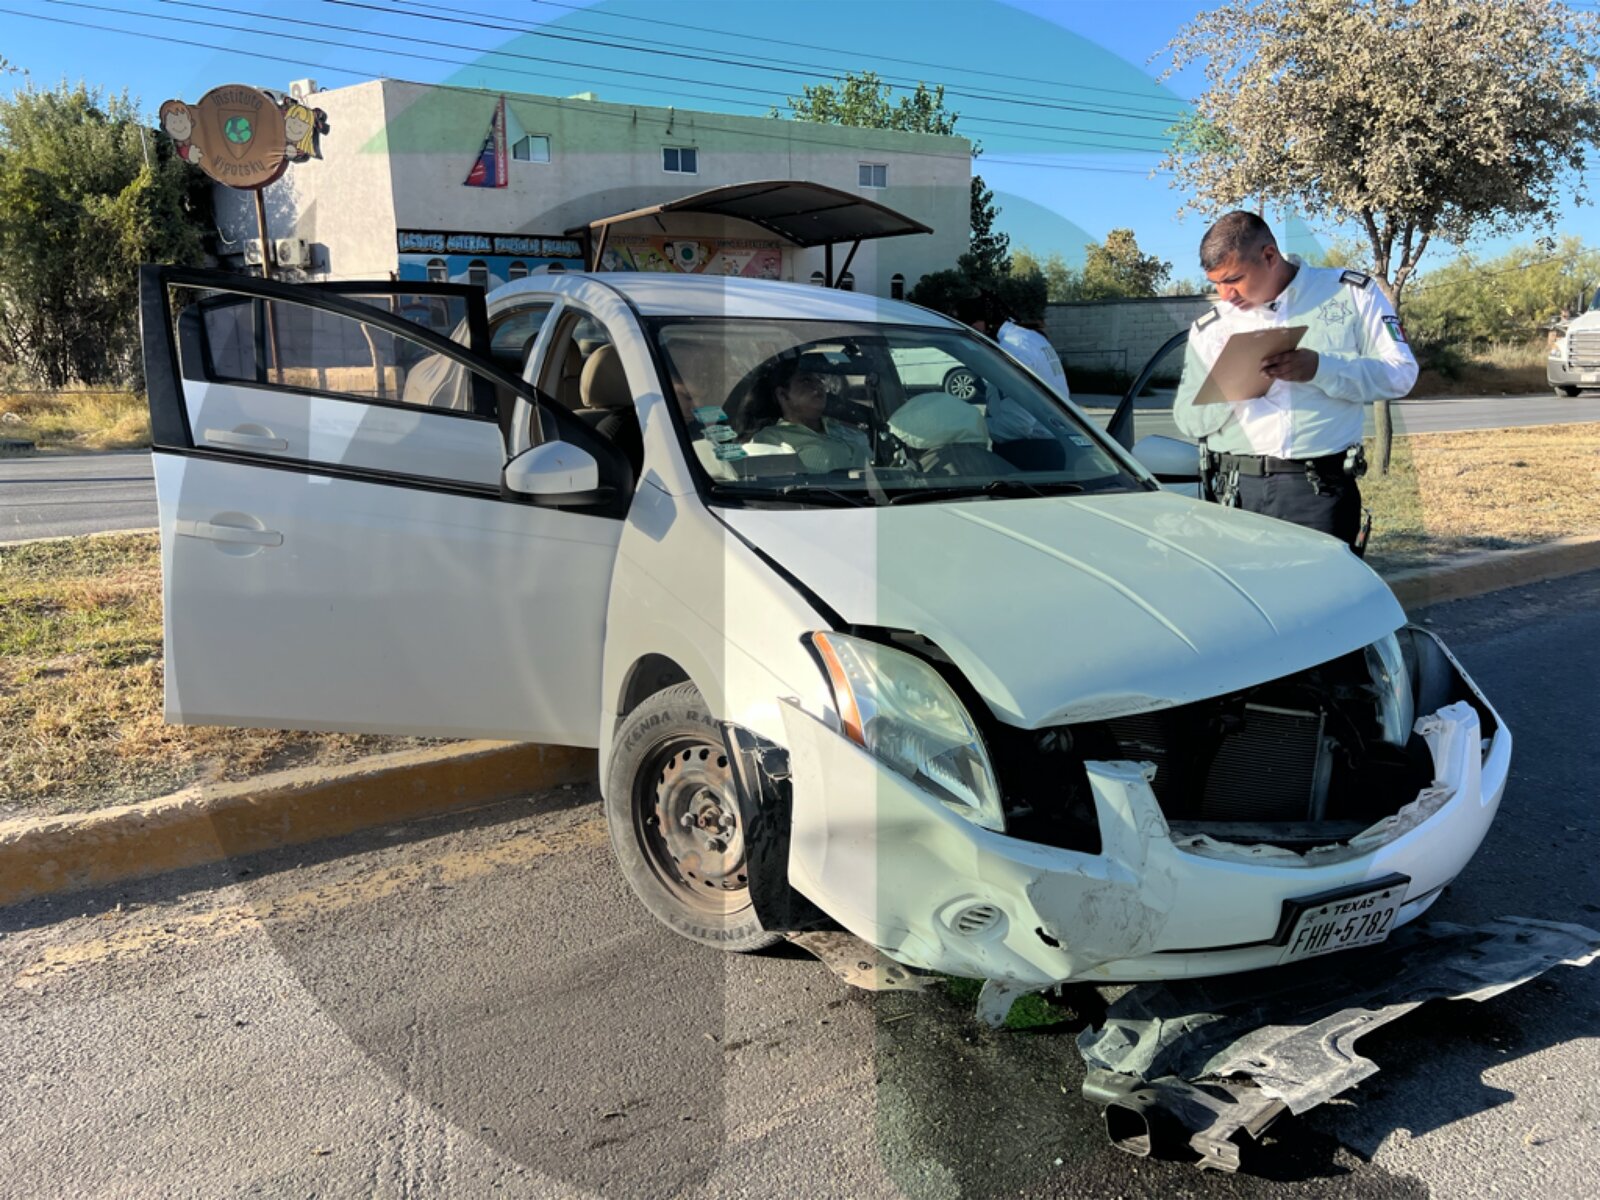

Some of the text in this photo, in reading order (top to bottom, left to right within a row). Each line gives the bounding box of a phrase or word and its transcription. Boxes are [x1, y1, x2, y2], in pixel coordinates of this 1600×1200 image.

[212, 89, 263, 110] Instituto
[624, 710, 671, 752] KENDA
[1333, 896, 1376, 916] TEXAS
